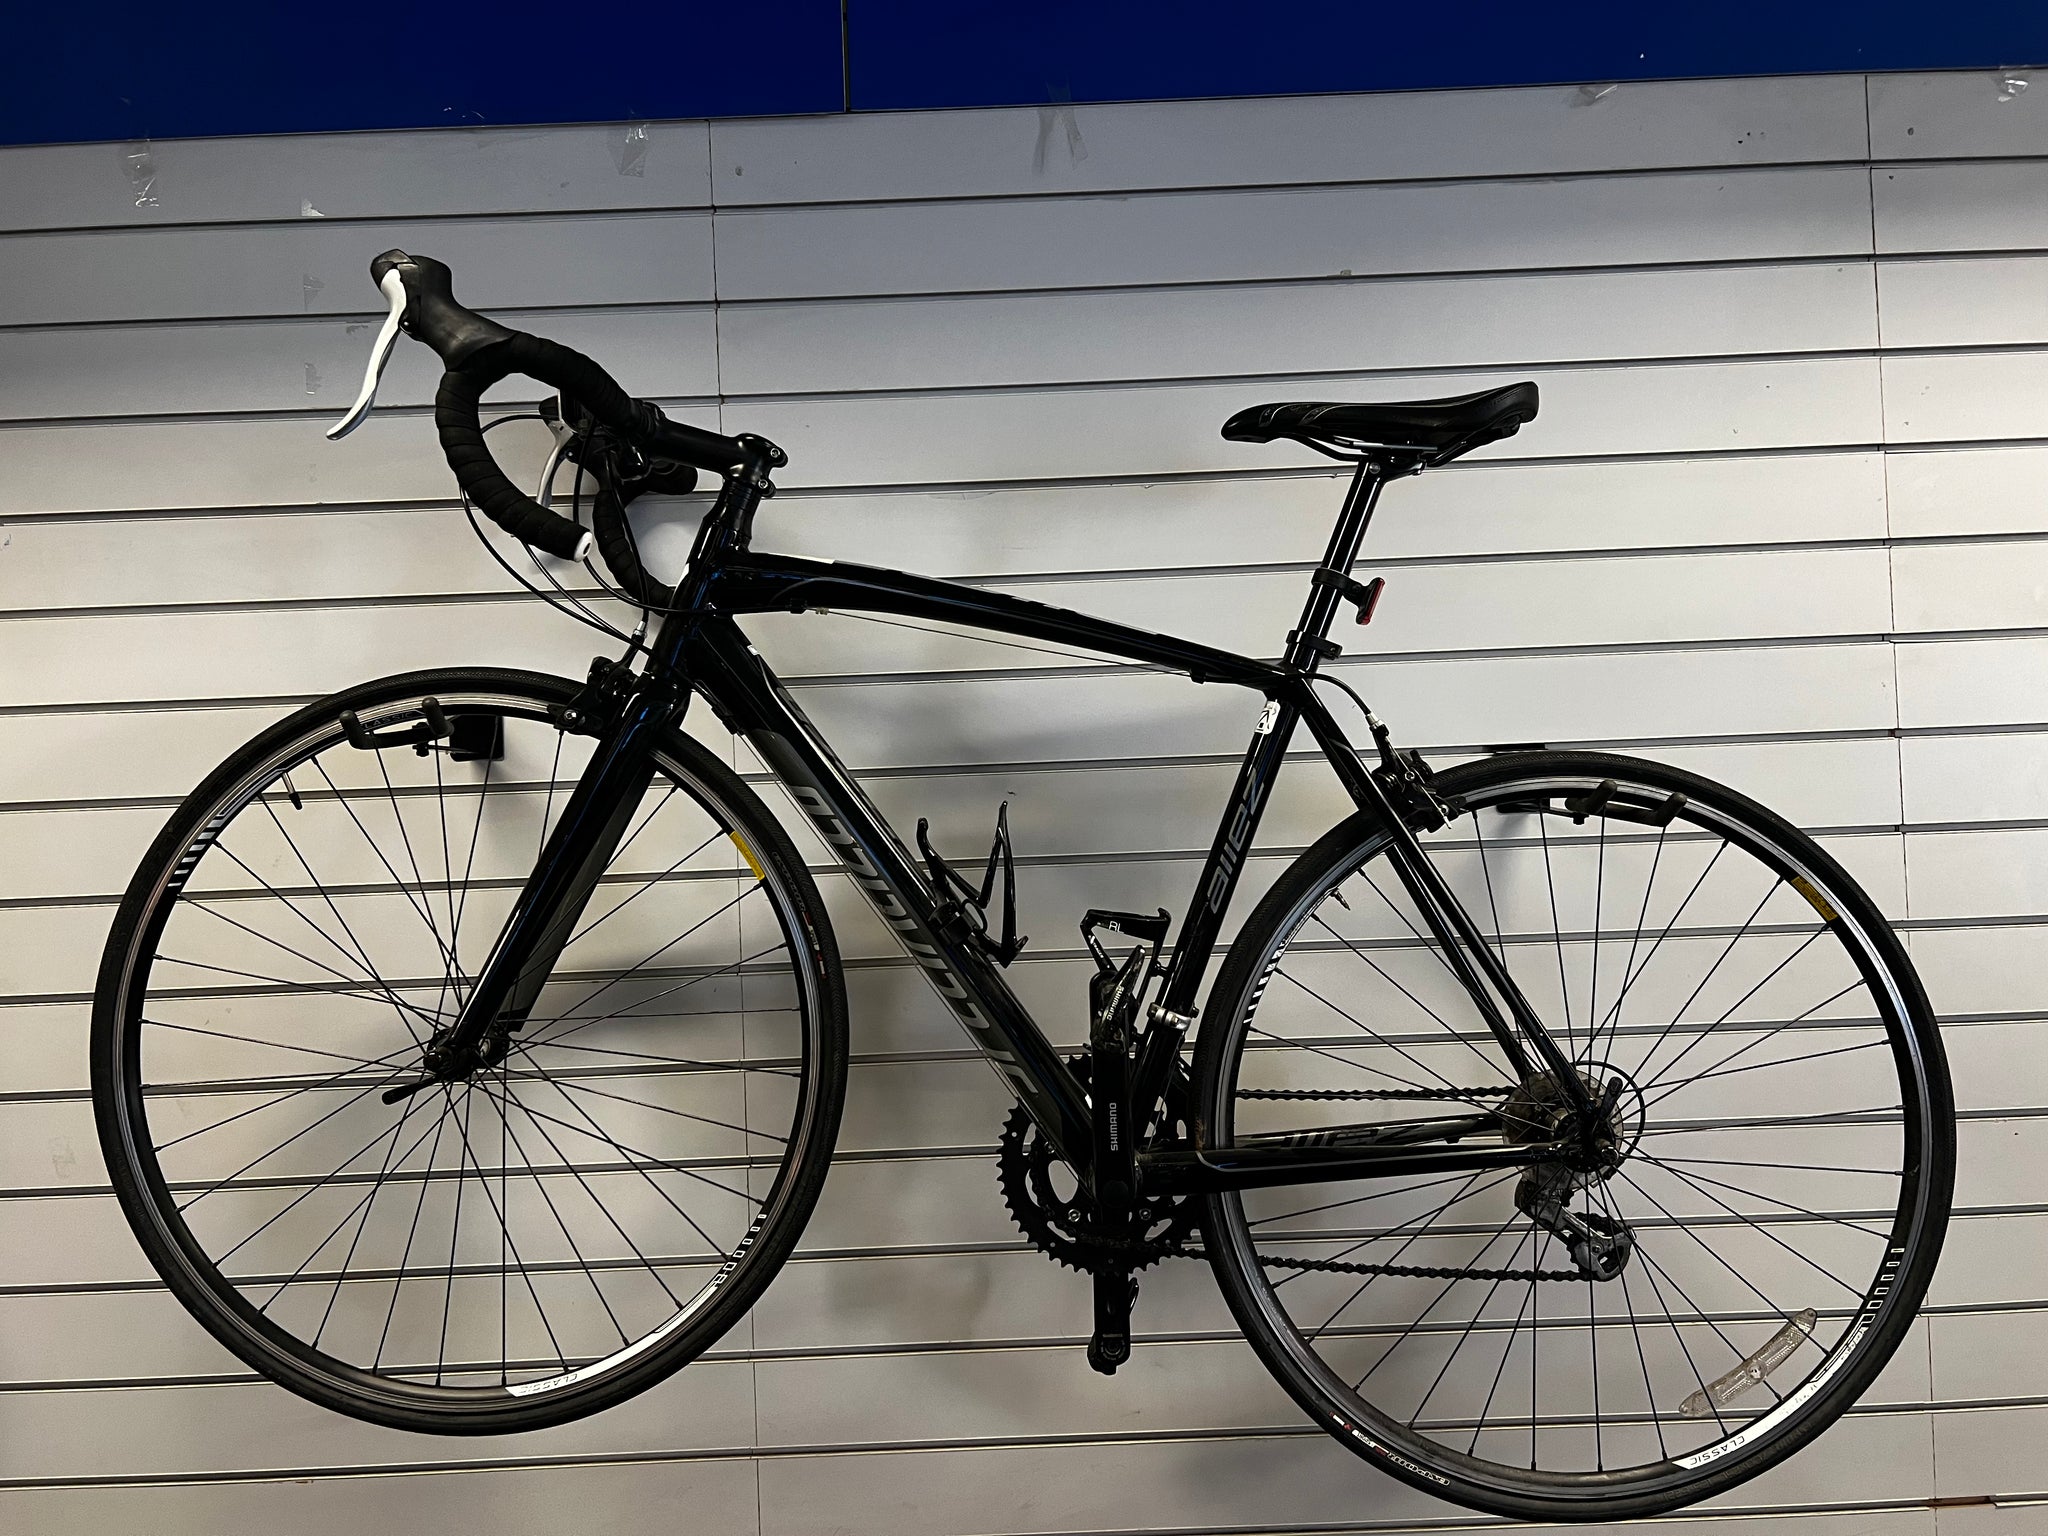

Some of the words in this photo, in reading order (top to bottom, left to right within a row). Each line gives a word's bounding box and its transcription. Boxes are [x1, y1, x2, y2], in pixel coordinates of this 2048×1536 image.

[1206, 766, 1264, 914] allez
[1109, 1102, 1118, 1151] SHIMANO
[519, 1373, 578, 1394] CLASSIC
[1690, 1435, 1745, 1466] CLASSIC
